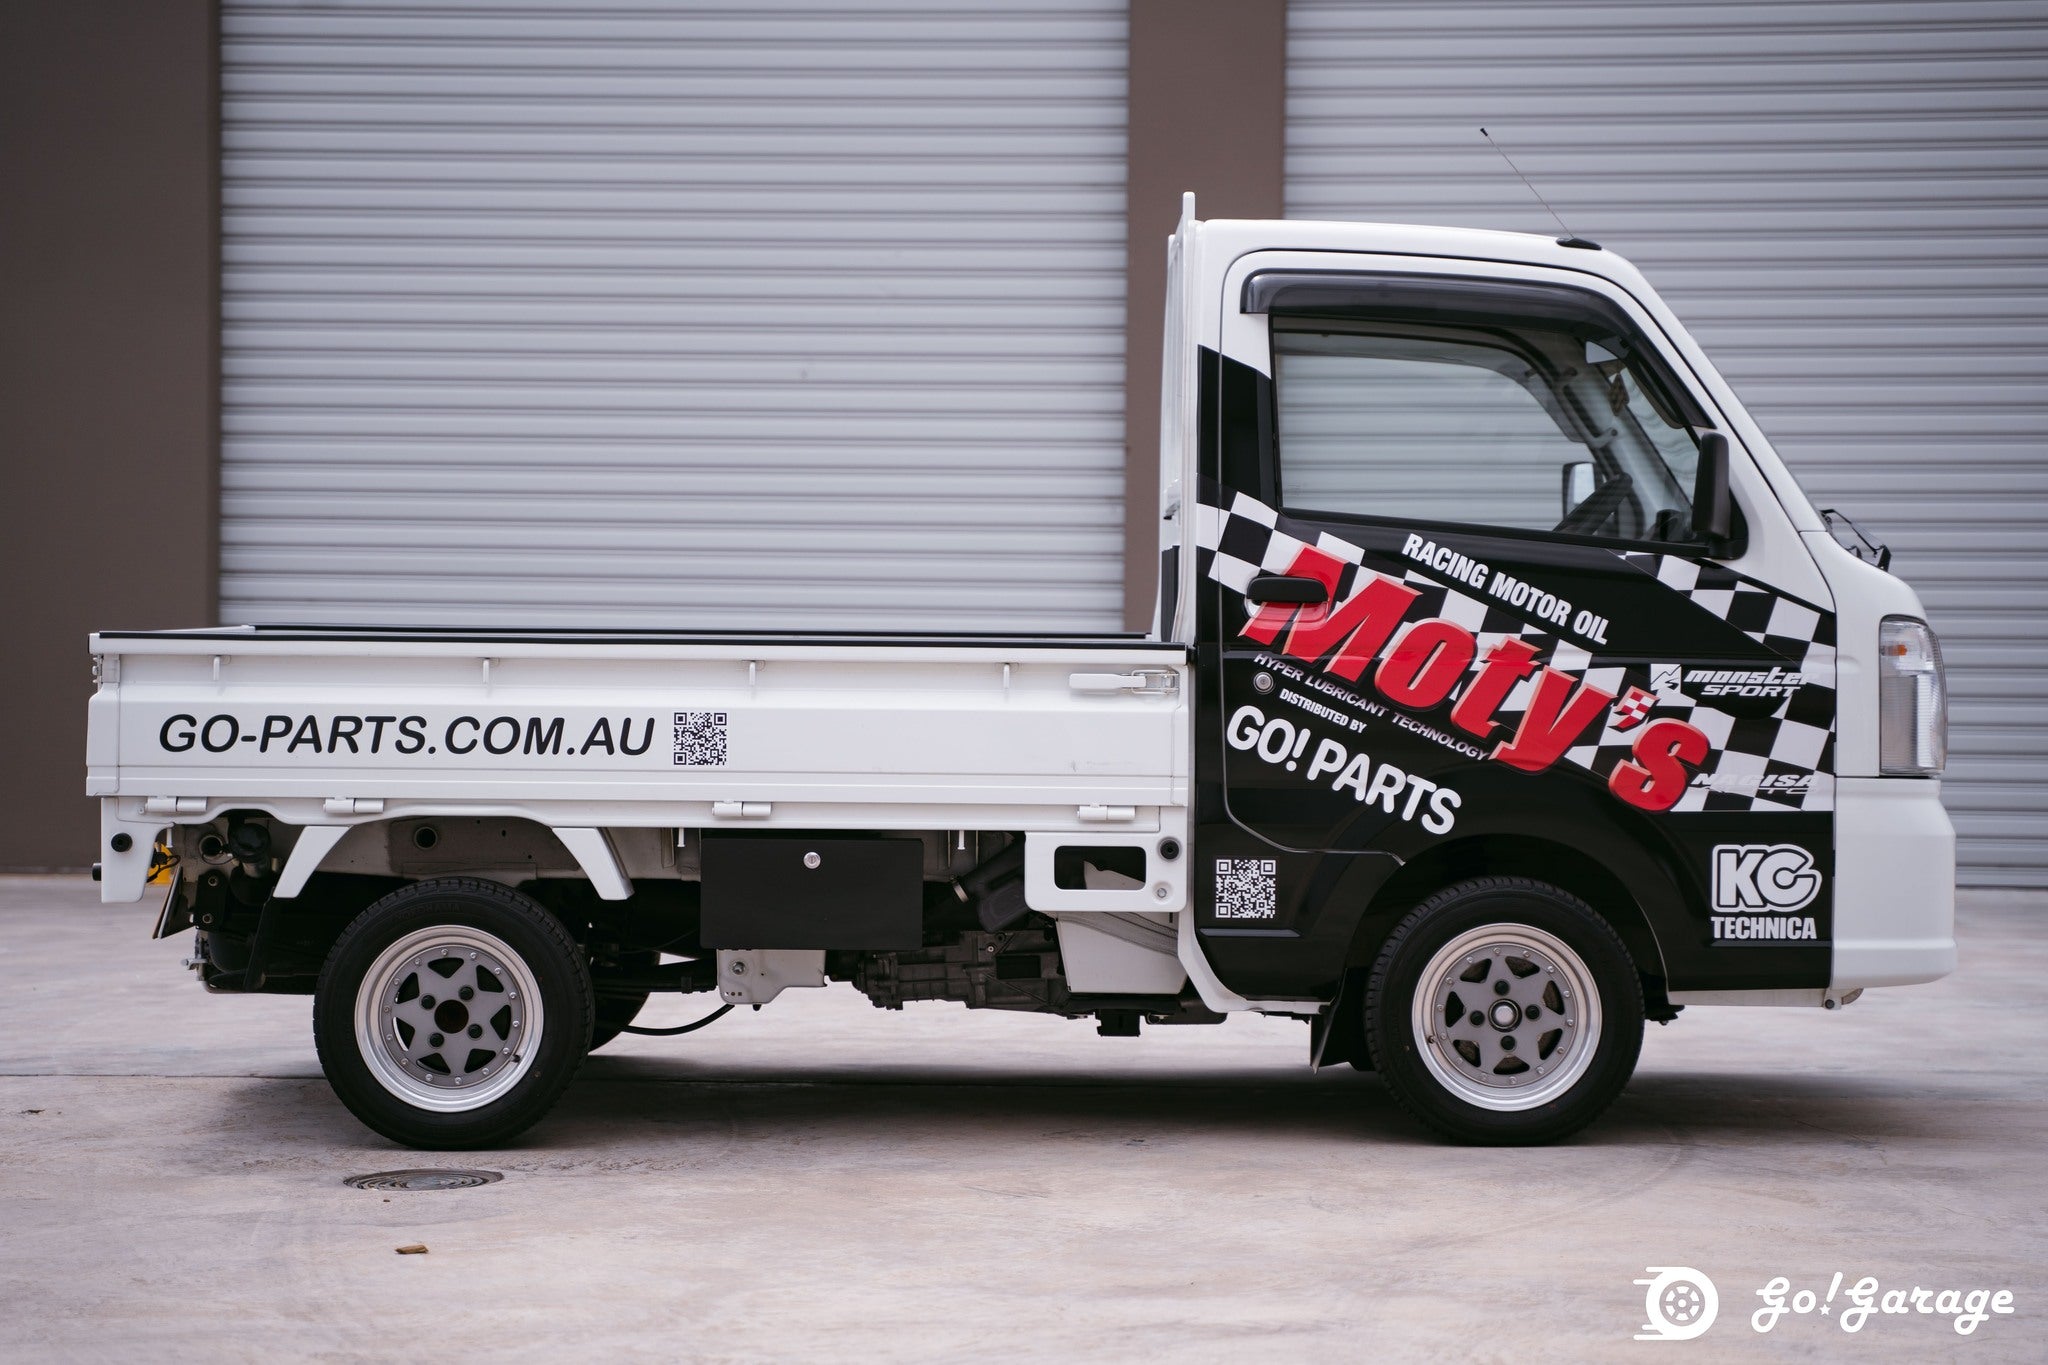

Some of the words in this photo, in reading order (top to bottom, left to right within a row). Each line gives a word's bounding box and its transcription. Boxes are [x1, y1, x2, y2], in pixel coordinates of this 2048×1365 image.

[1401, 532, 1489, 590] RACING
[1488, 571, 1573, 626] MOTOR
[1573, 609, 1610, 645] OIL
[1238, 543, 1711, 812] Moty's
[1684, 666, 1818, 685] monster
[1701, 684, 1802, 698] SPORT
[160, 713, 656, 756] GO-PARTS.COM.AU
[1253, 653, 1303, 681] HYPER
[1304, 675, 1390, 717] LUBRICANT
[1391, 712, 1490, 761] TECHNOLOGY
[1279, 688, 1350, 727] DISTRIBUTED
[1348, 720, 1368, 734] BY
[1226, 704, 1311, 773] GO!
[1307, 738, 1462, 835] PARTS
[1712, 844, 1822, 912] KC
[1710, 916, 1818, 940] TECHNICA
